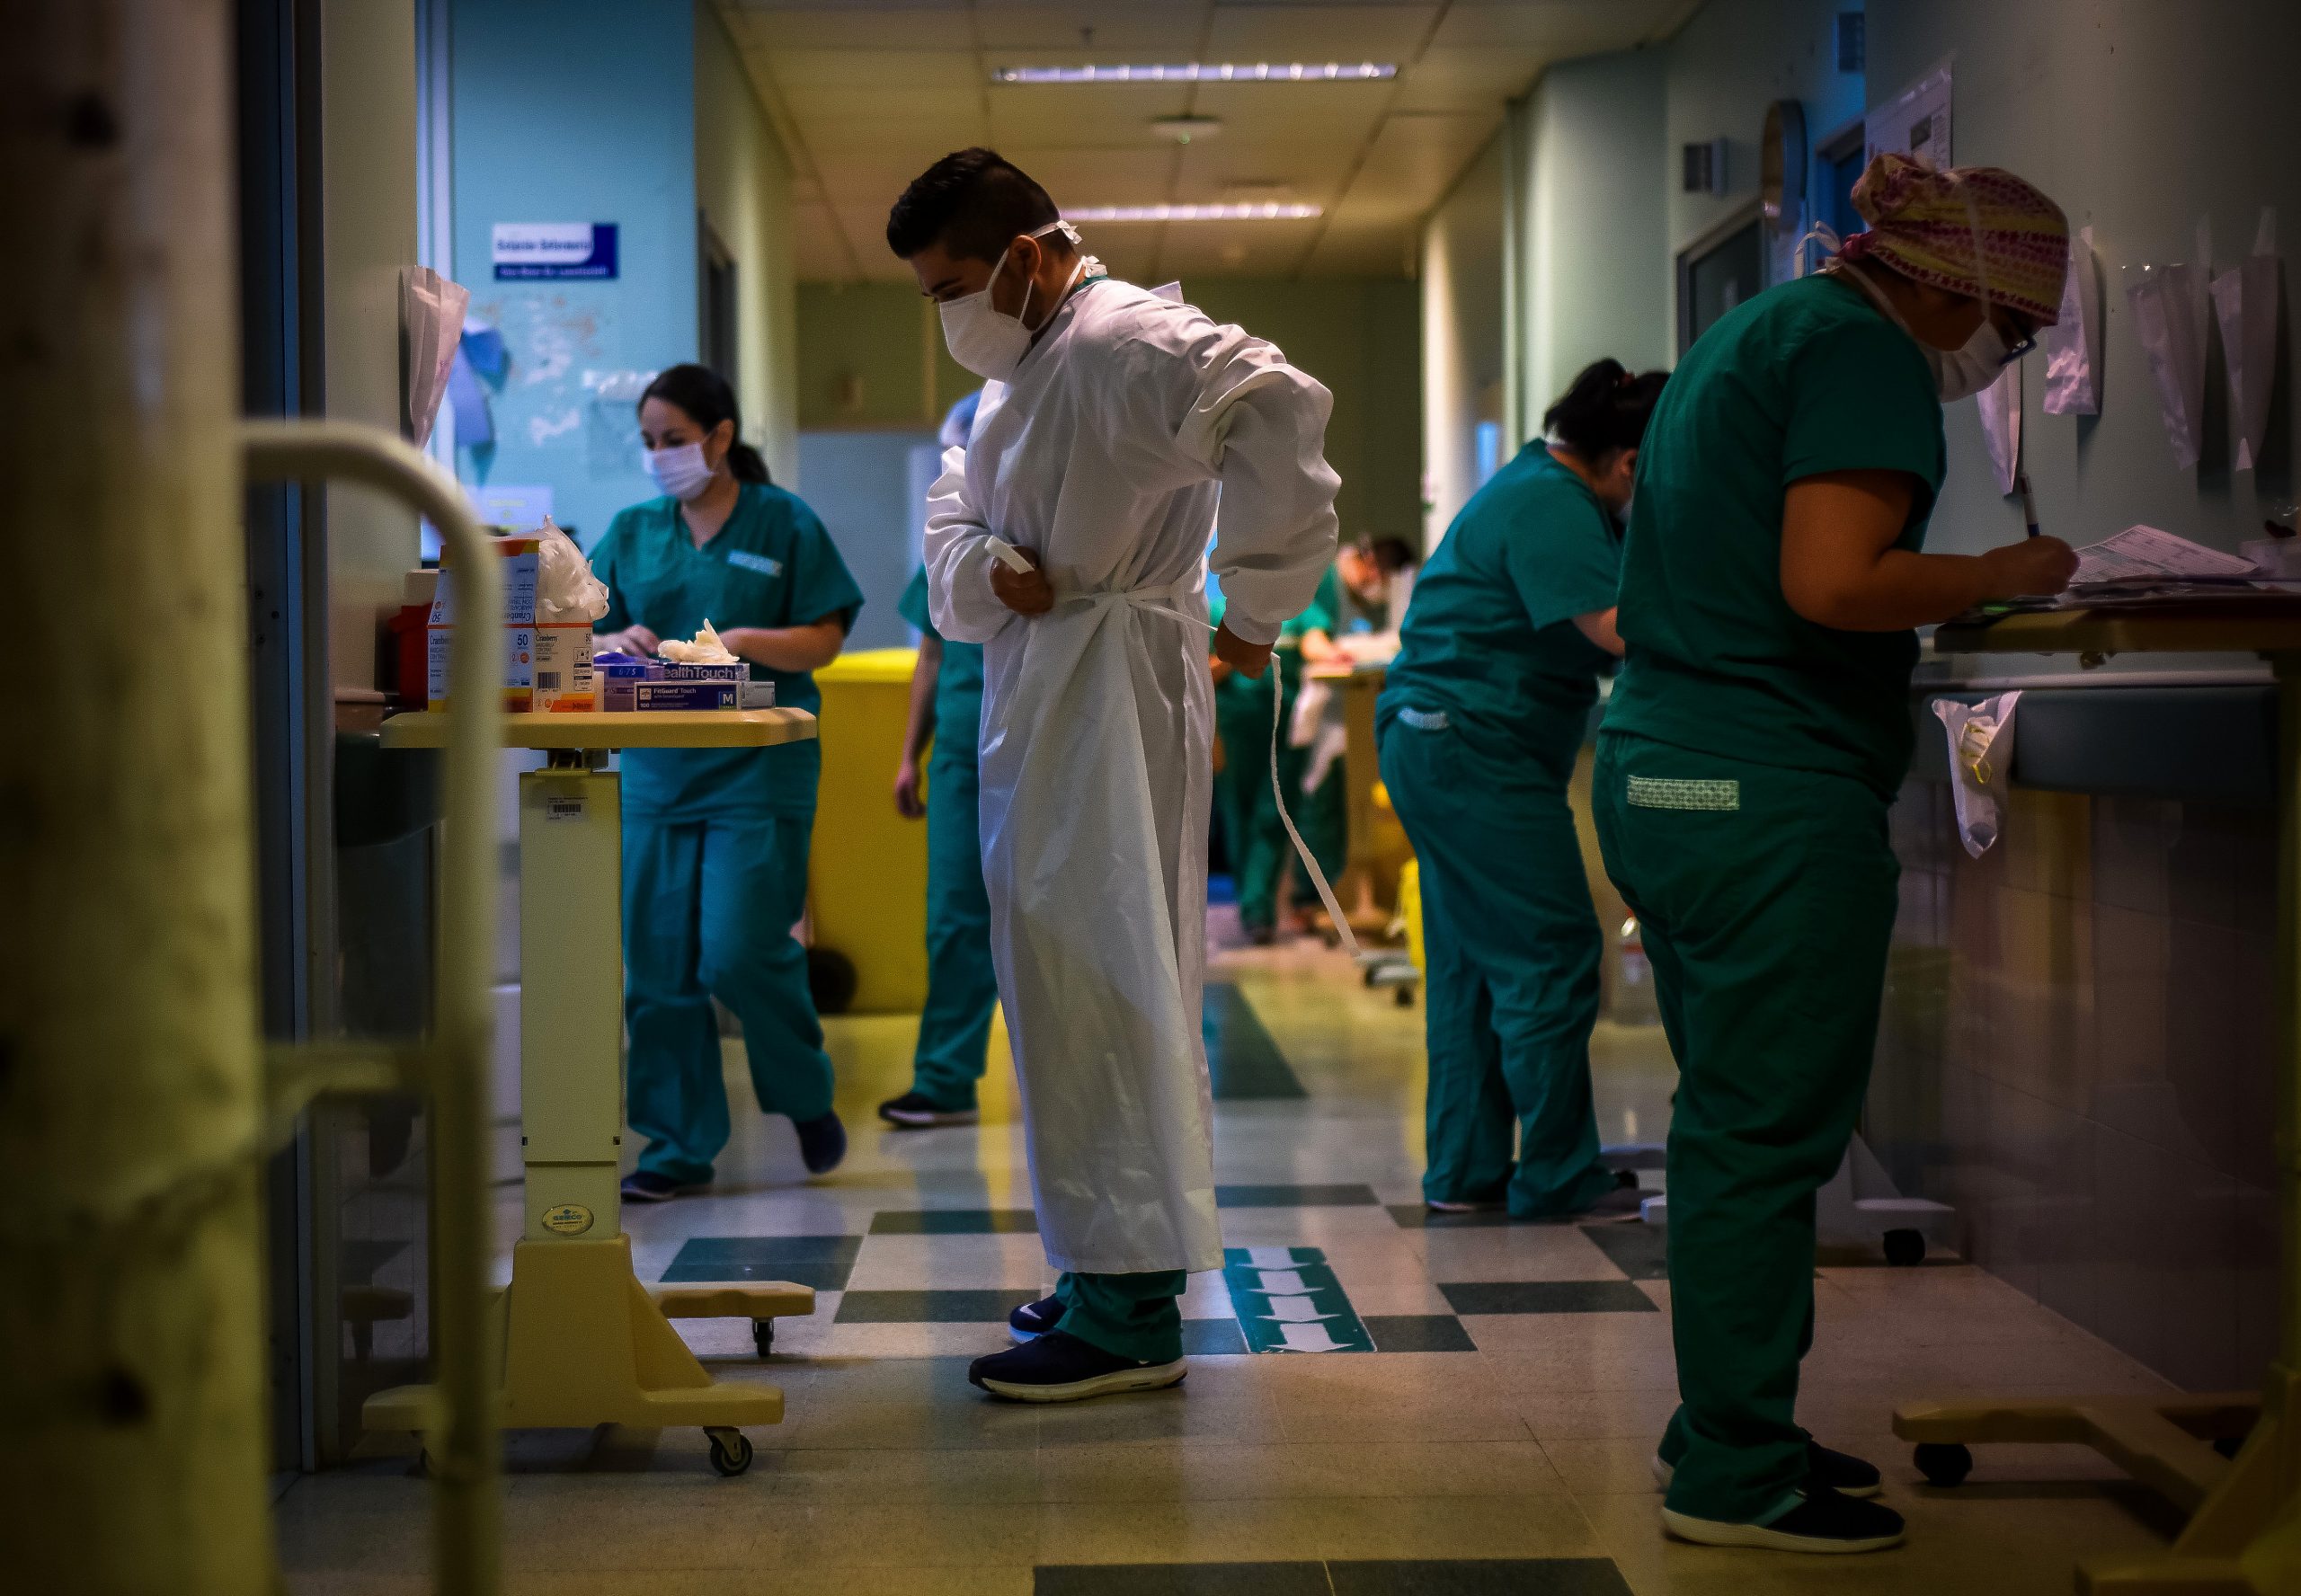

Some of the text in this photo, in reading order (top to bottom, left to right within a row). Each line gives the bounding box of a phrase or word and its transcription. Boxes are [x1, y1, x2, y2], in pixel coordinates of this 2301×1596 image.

[517, 634, 529, 646] 50
[536, 634, 558, 643] Cranberry
[664, 666, 733, 679] ealthTouch
[723, 693, 733, 705] M
